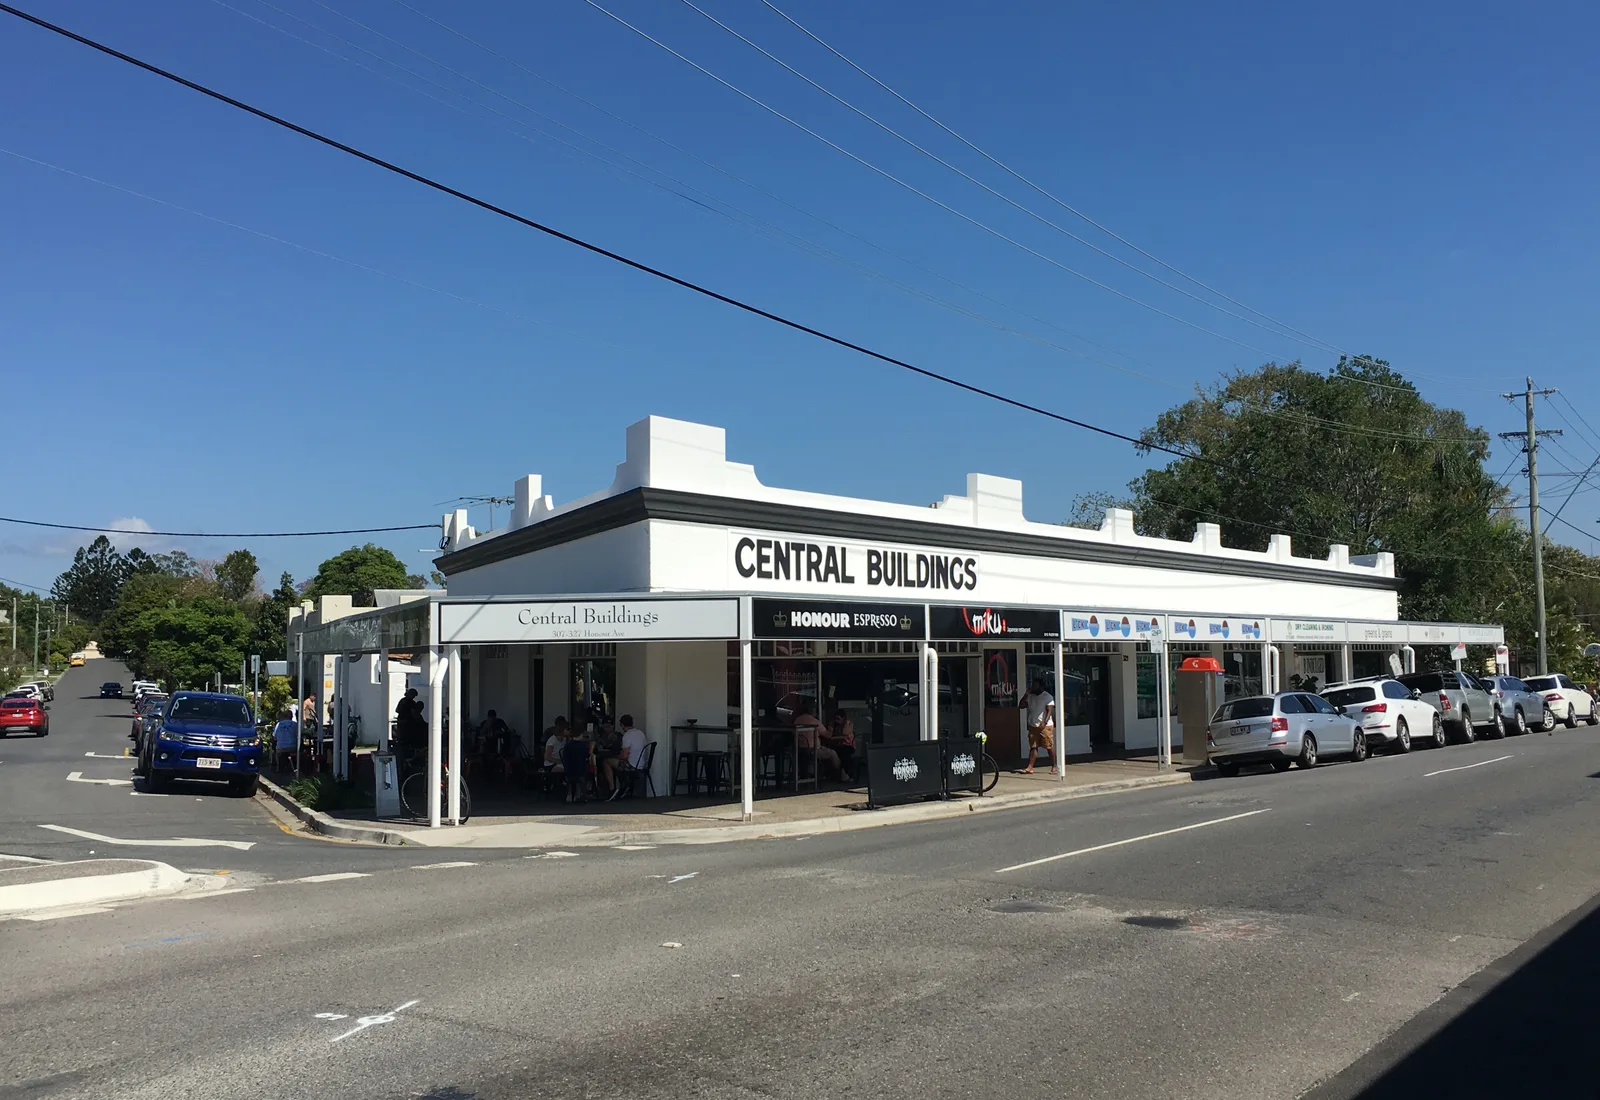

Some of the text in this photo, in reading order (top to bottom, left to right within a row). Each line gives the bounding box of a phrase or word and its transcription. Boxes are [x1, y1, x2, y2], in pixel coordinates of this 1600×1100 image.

[735, 537, 977, 590] CENTRAL BUILDINGS
[518, 605, 659, 627] Central Buildings
[791, 611, 850, 628] HONOUR
[972, 611, 1002, 634] miku
[552, 629, 625, 638] 307-327 Honour Ave
[893, 764, 918, 775] HONOUR
[951, 760, 976, 770] HONOUR
